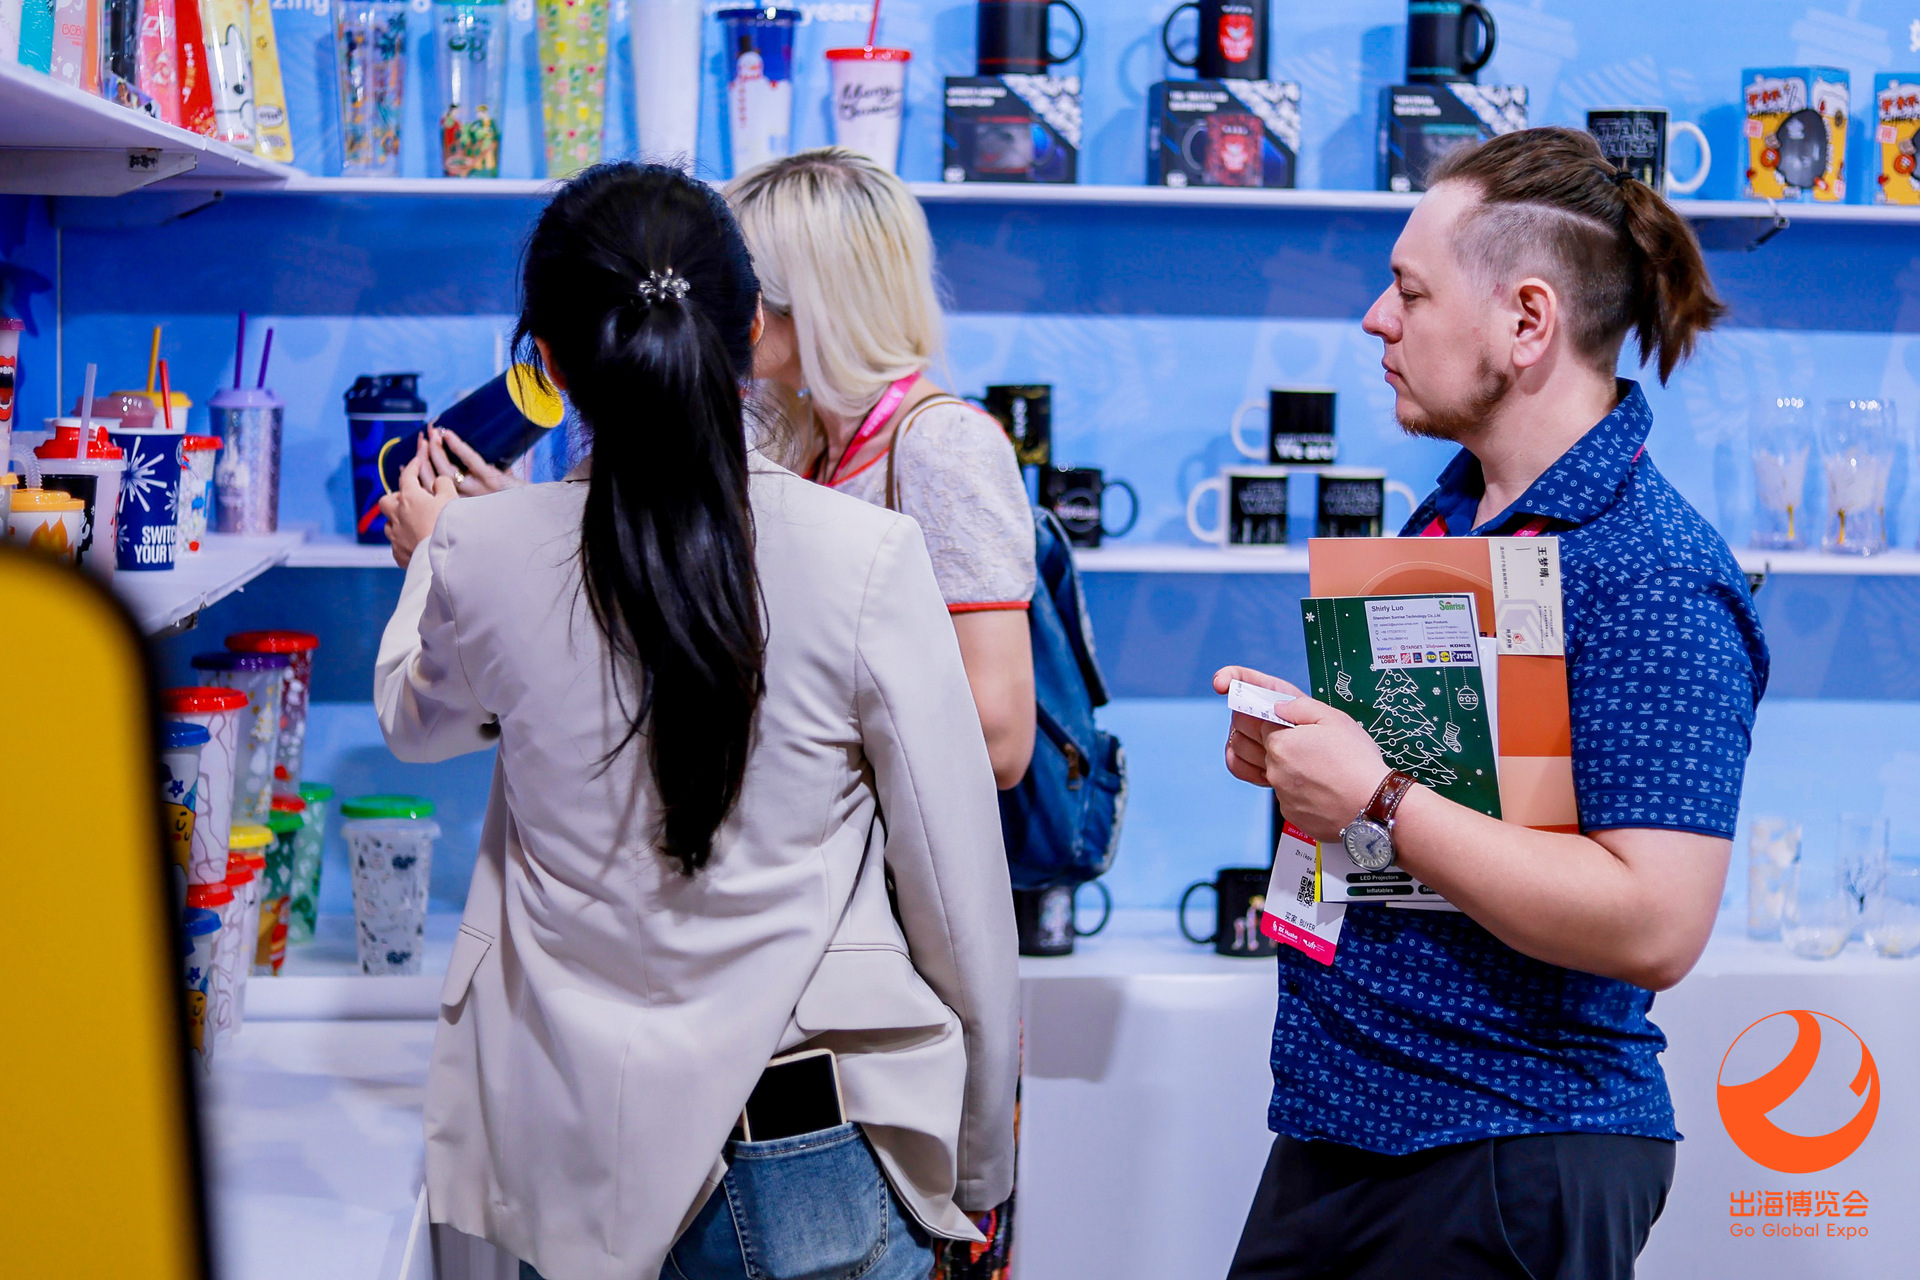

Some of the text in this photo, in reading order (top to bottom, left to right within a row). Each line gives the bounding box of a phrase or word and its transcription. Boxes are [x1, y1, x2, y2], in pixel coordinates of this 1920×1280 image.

[134, 544, 167, 564] YOUR
[1391, 604, 1404, 612] Luo
[1439, 600, 1466, 611] Sunrise
[1298, 918, 1316, 932] BUYER
